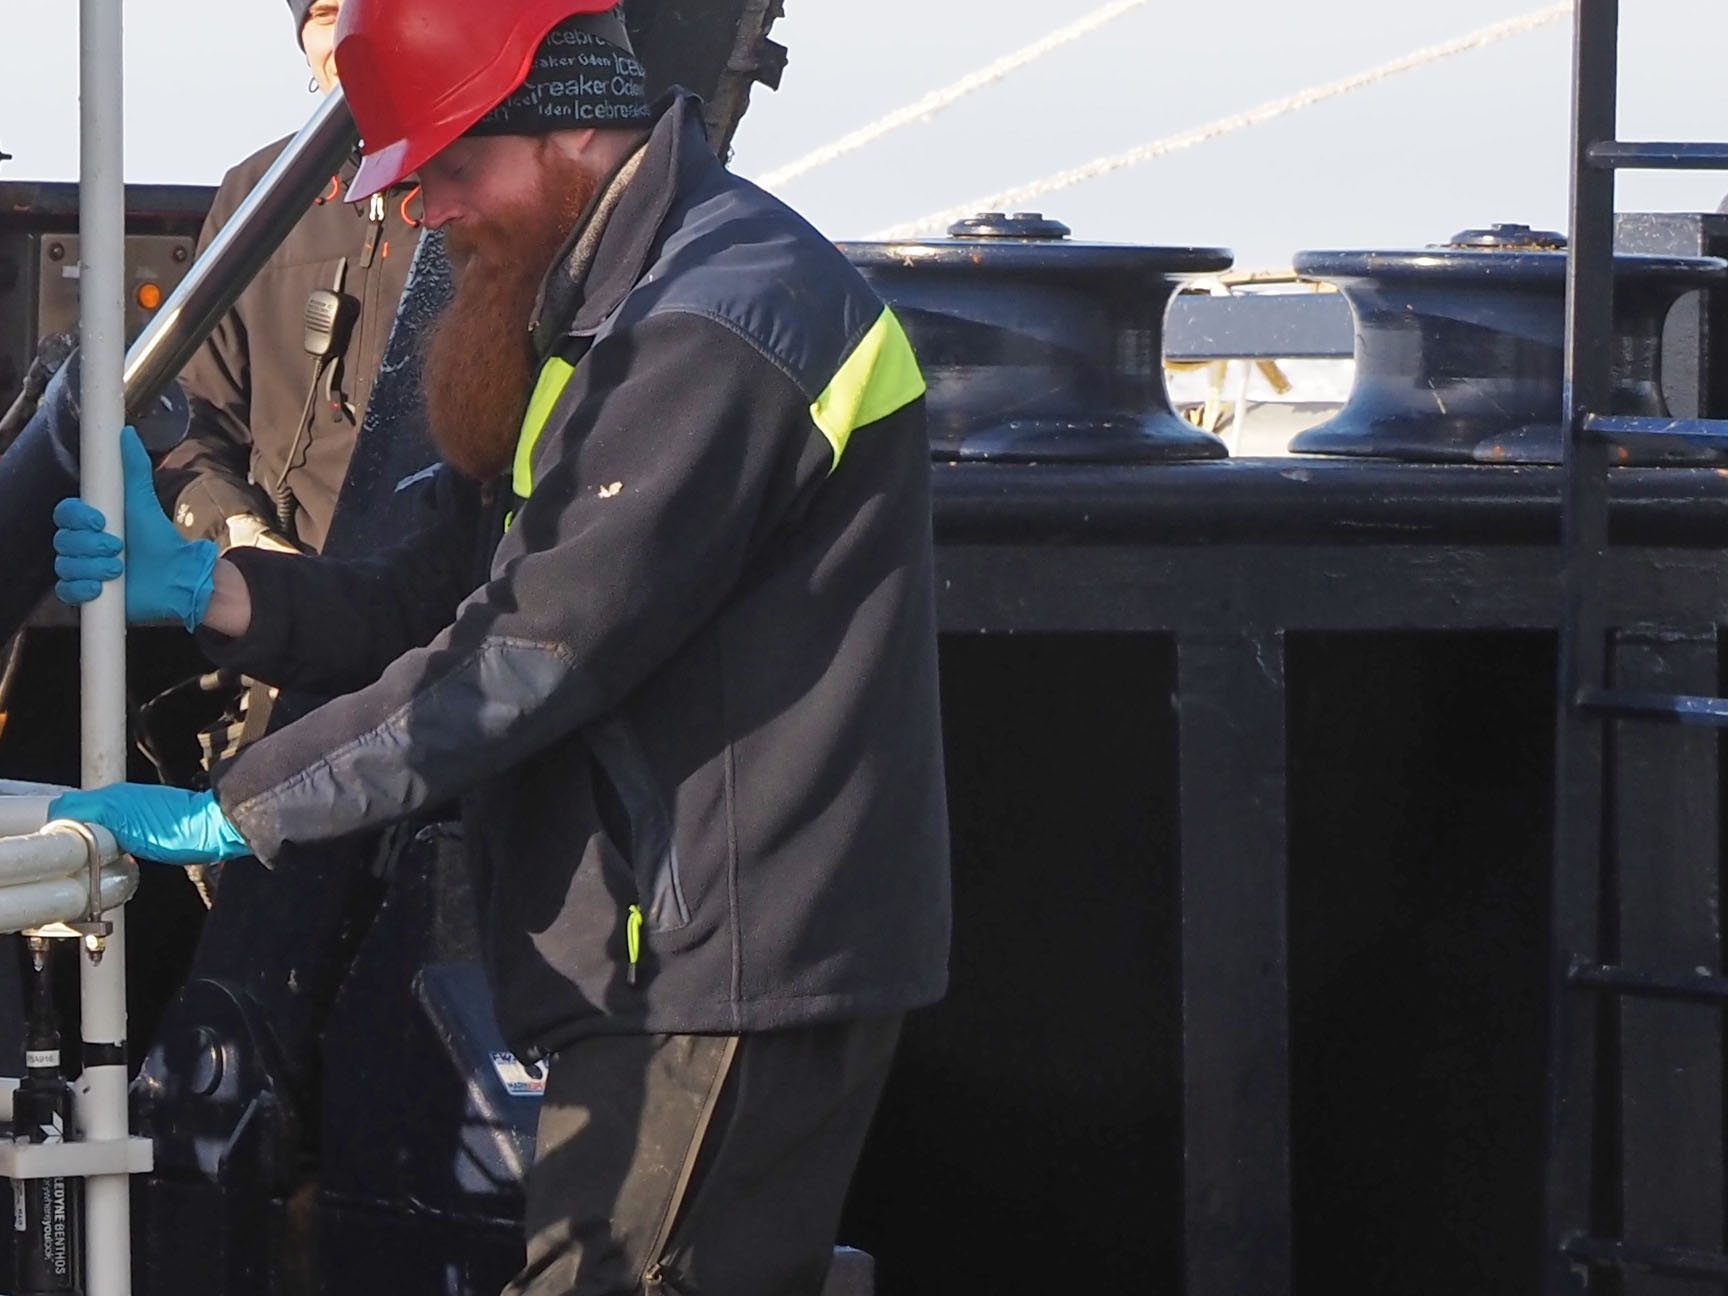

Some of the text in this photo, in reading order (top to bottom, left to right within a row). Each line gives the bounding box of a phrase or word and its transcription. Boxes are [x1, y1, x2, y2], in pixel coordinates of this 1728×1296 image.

[532, 55, 575, 69] aker
[524, 73, 611, 99] reaker
[54, 1177, 66, 1223] LEDYNE
